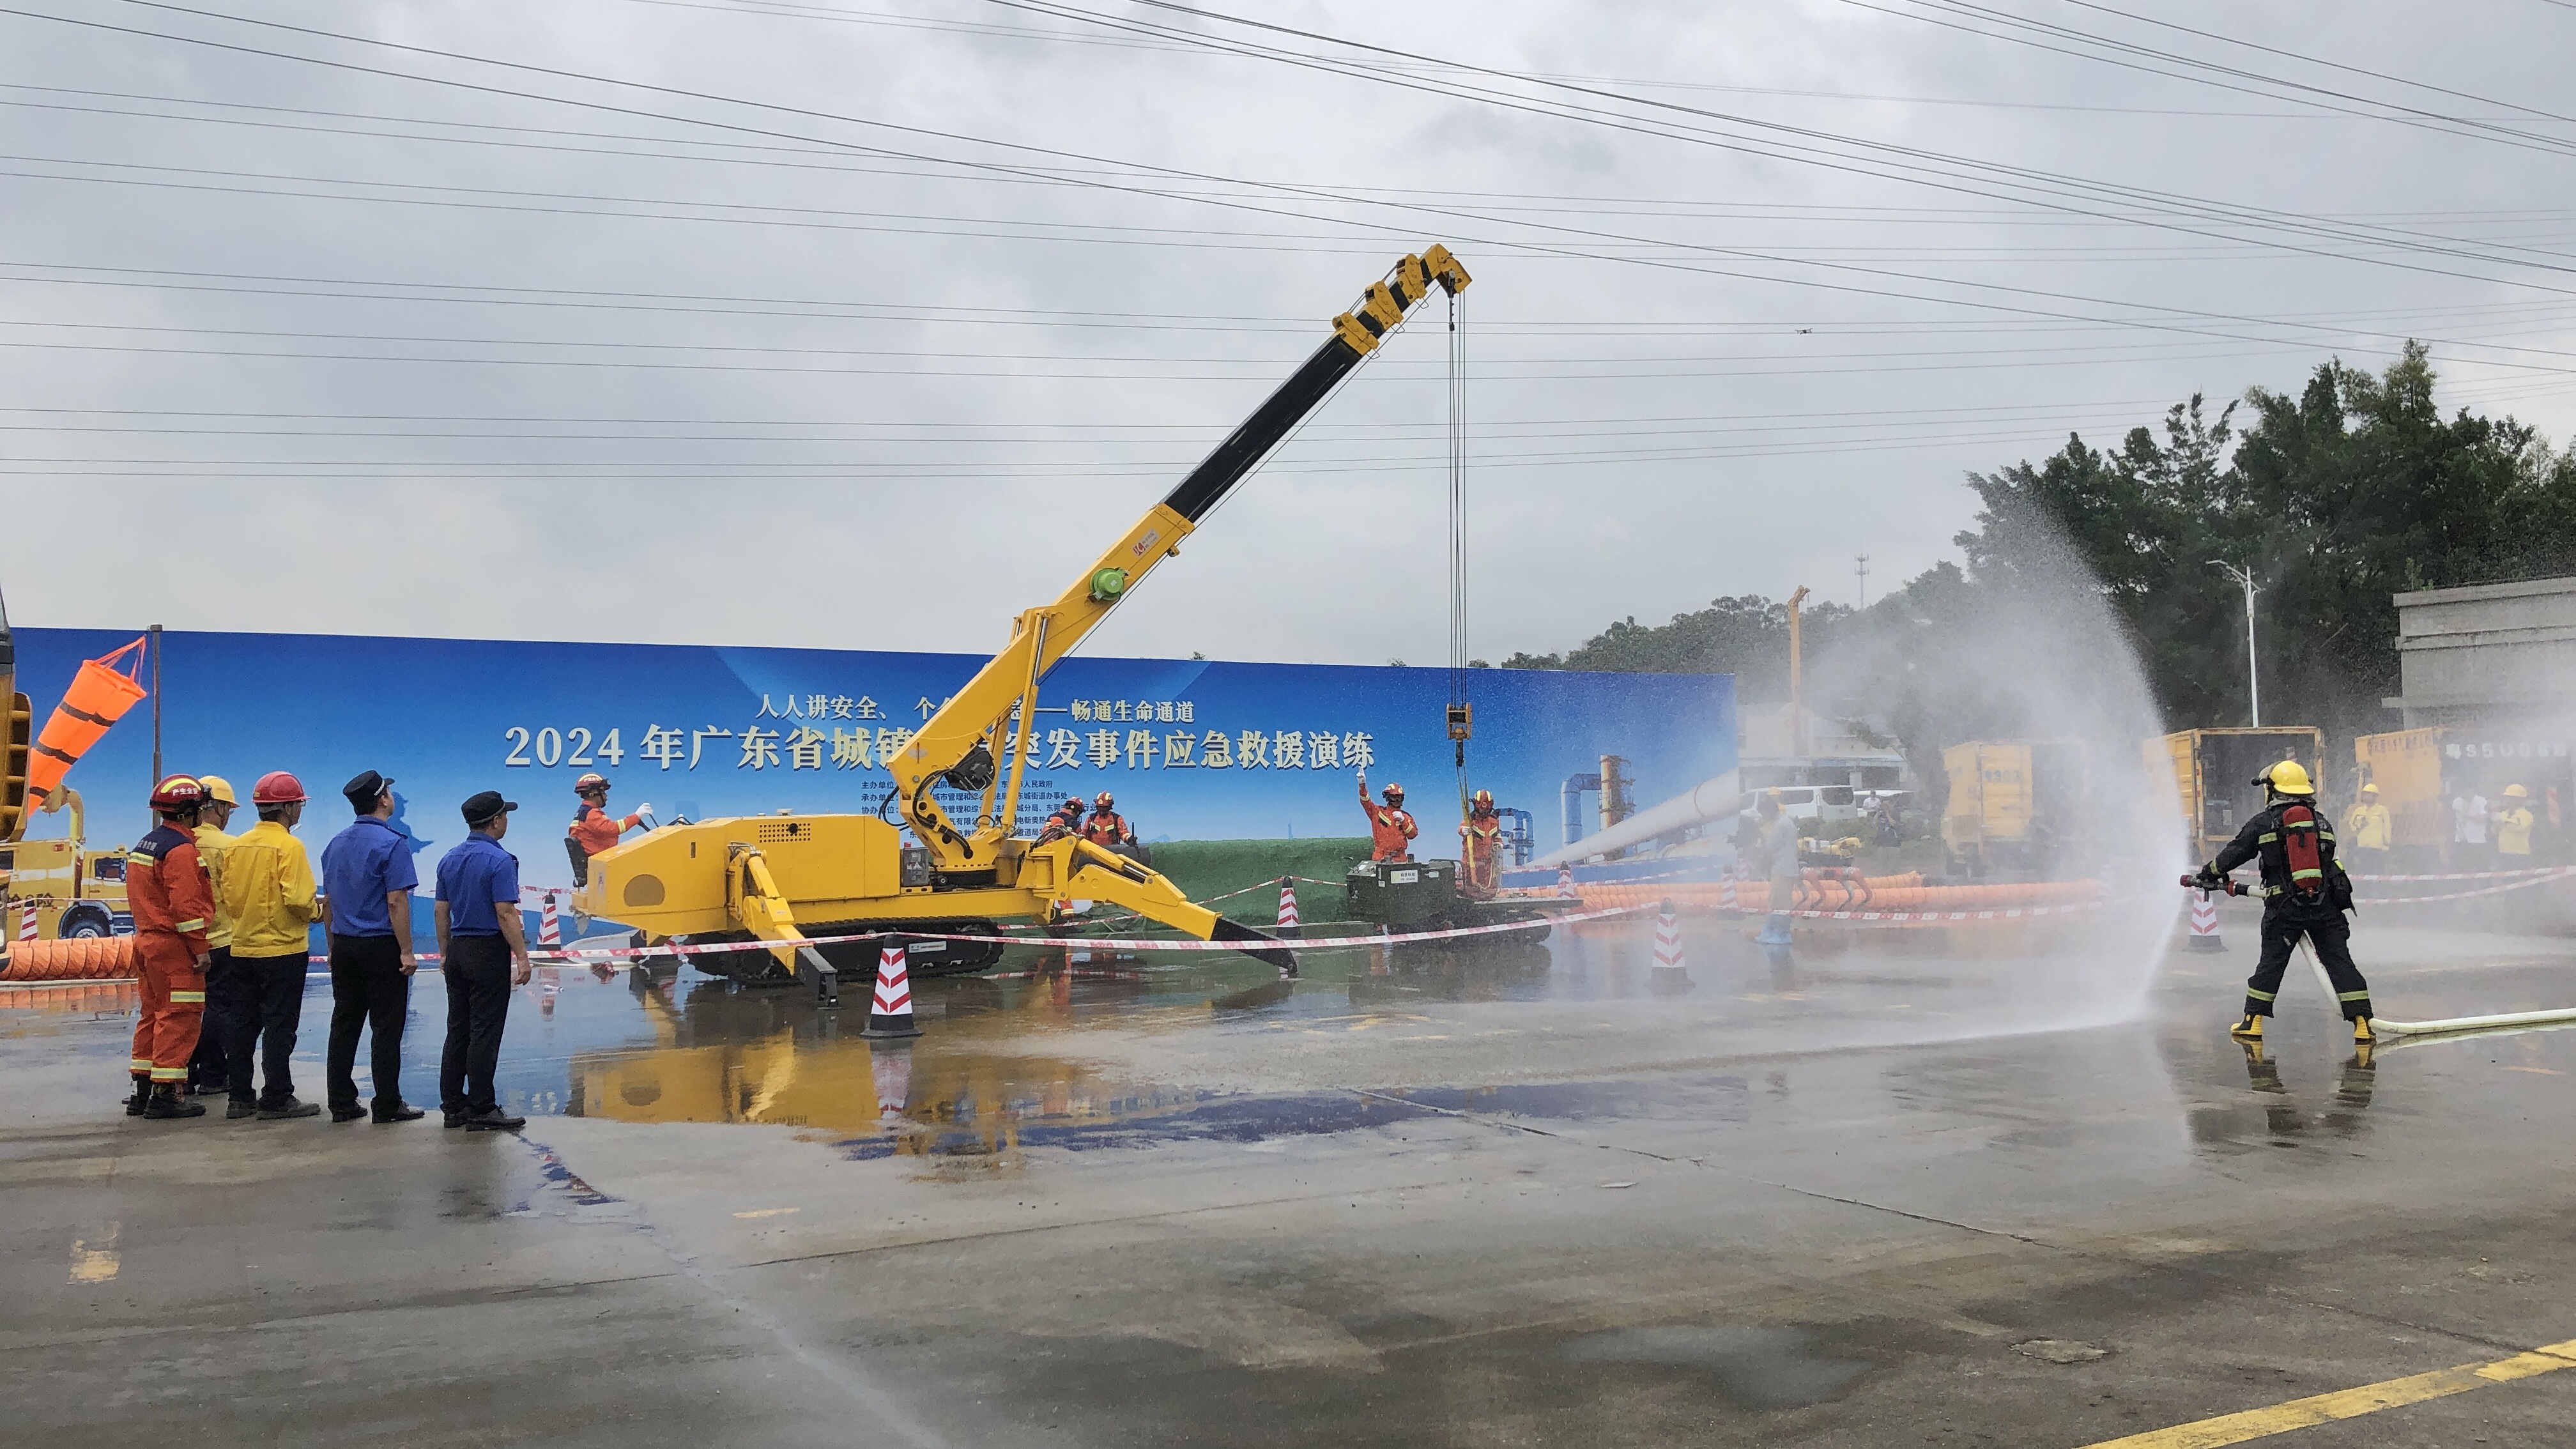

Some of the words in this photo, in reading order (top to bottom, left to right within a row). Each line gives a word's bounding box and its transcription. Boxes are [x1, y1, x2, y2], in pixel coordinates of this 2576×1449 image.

[756, 694, 887, 721] 人人讲安全、
[505, 727, 624, 767] 2024
